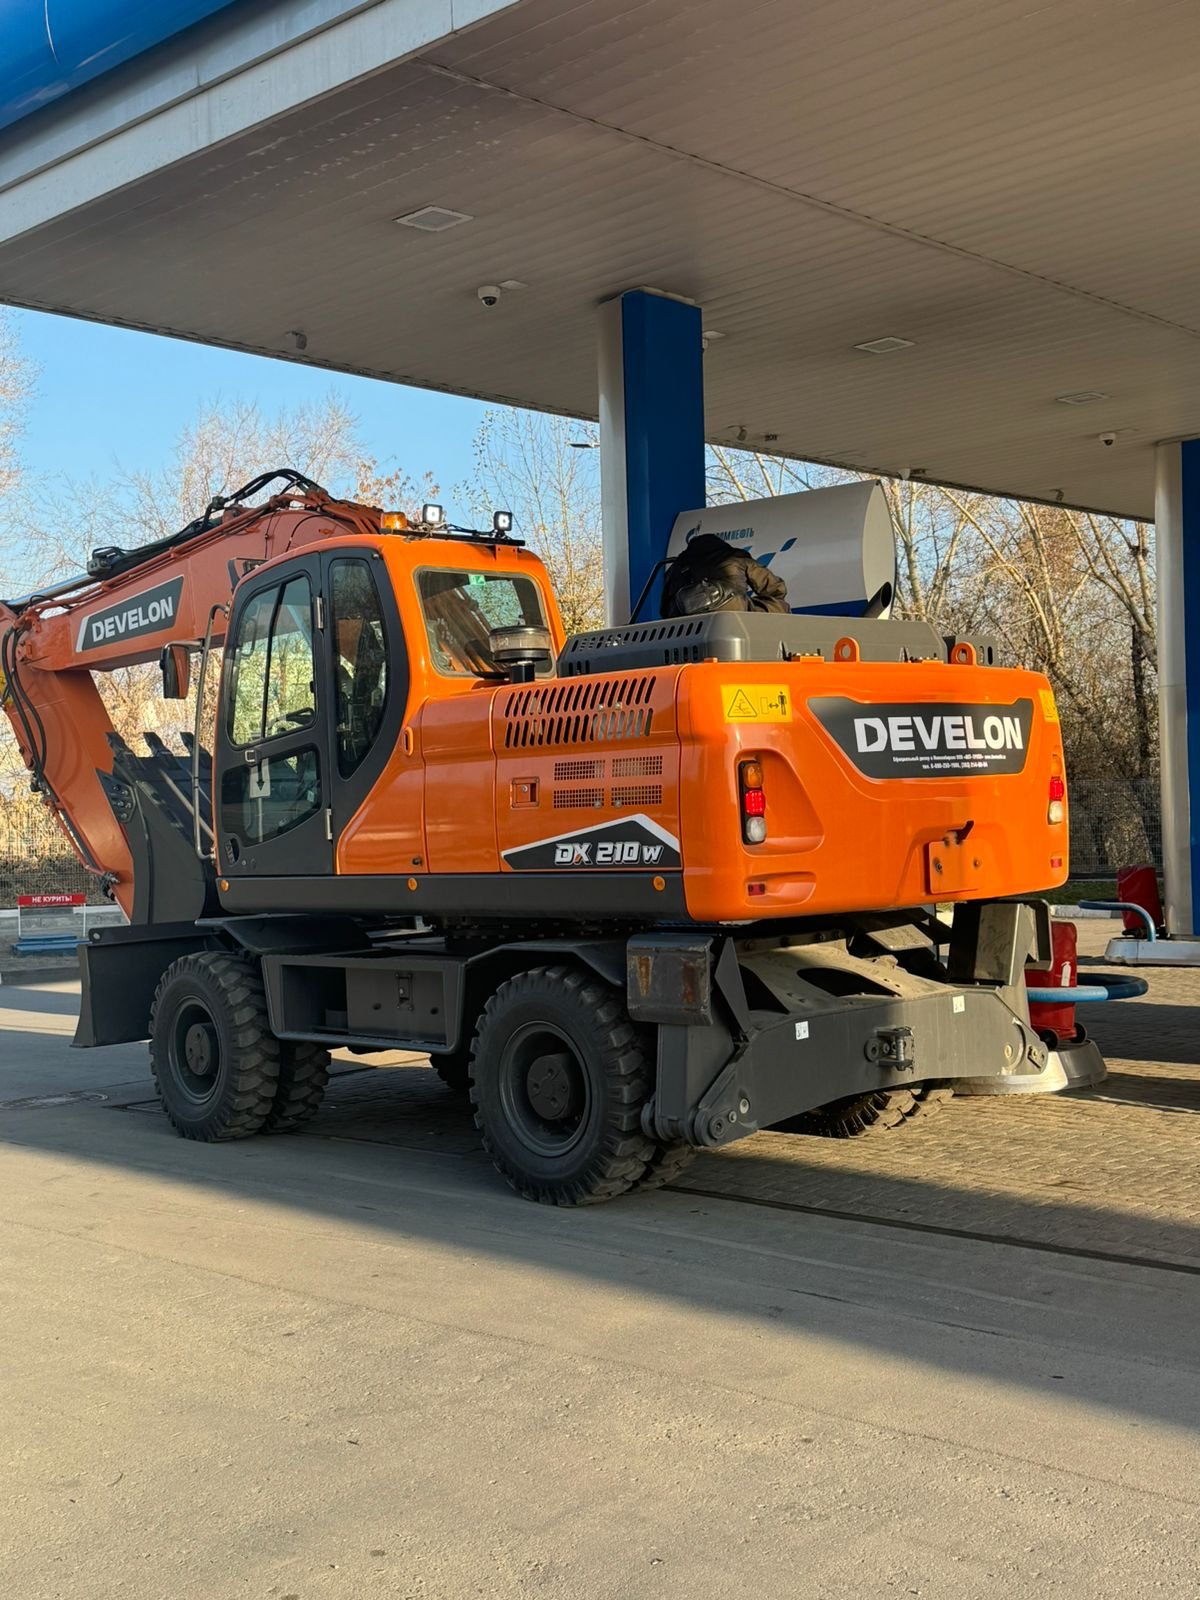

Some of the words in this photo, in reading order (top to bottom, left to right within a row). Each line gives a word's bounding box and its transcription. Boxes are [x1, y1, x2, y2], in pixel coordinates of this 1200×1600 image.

[91, 596, 174, 643] DEVELON
[853, 715, 1024, 753] DEVELON
[554, 842, 593, 865] DX
[31, 896, 42, 904] НЕ
